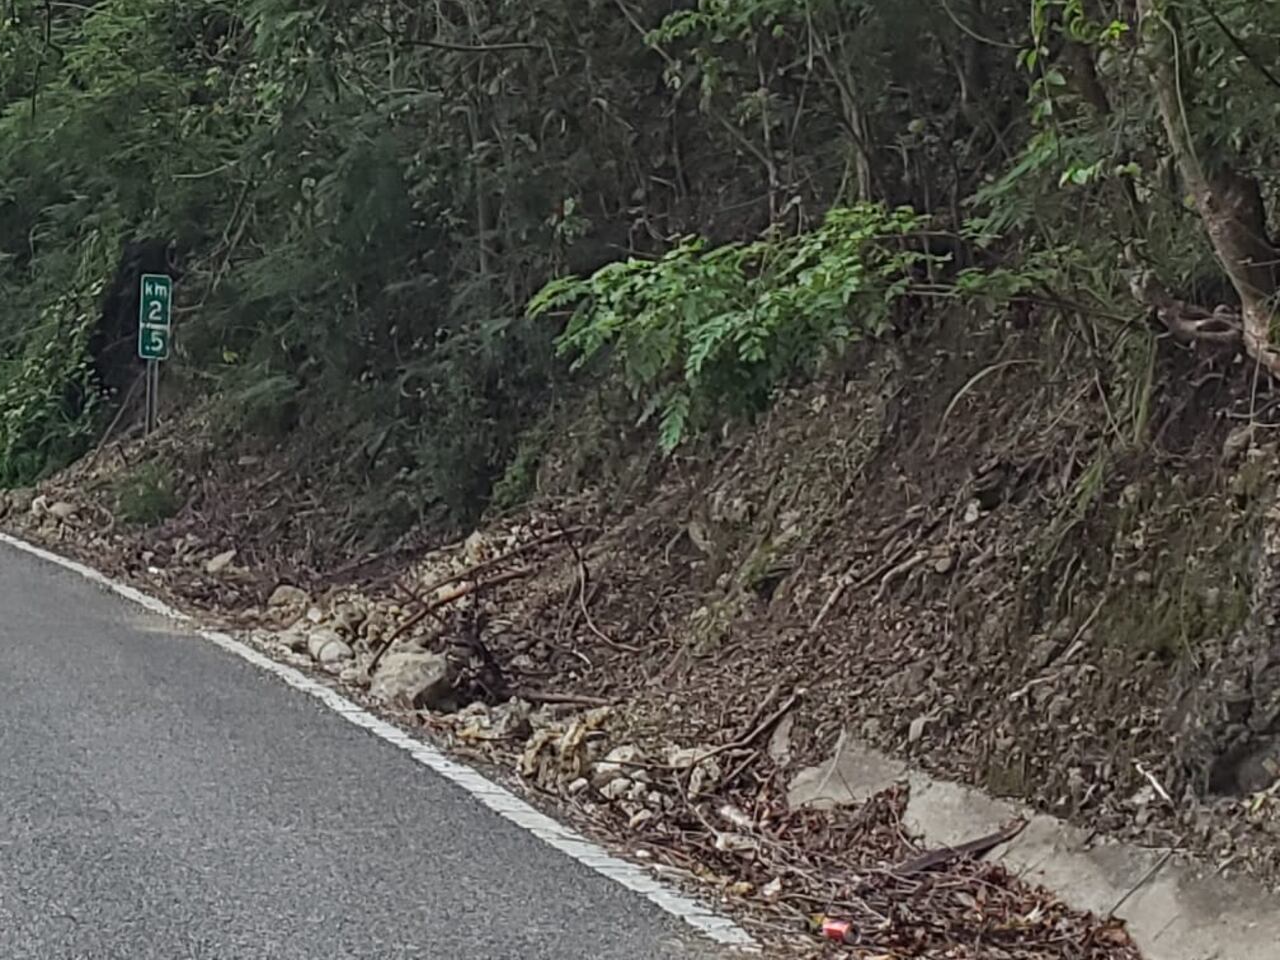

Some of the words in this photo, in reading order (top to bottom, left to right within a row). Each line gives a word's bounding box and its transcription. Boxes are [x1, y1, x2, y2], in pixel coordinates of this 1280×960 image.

[145, 281, 168, 297] km
[149, 300, 162, 320] 2
[145, 331, 163, 351] .5
